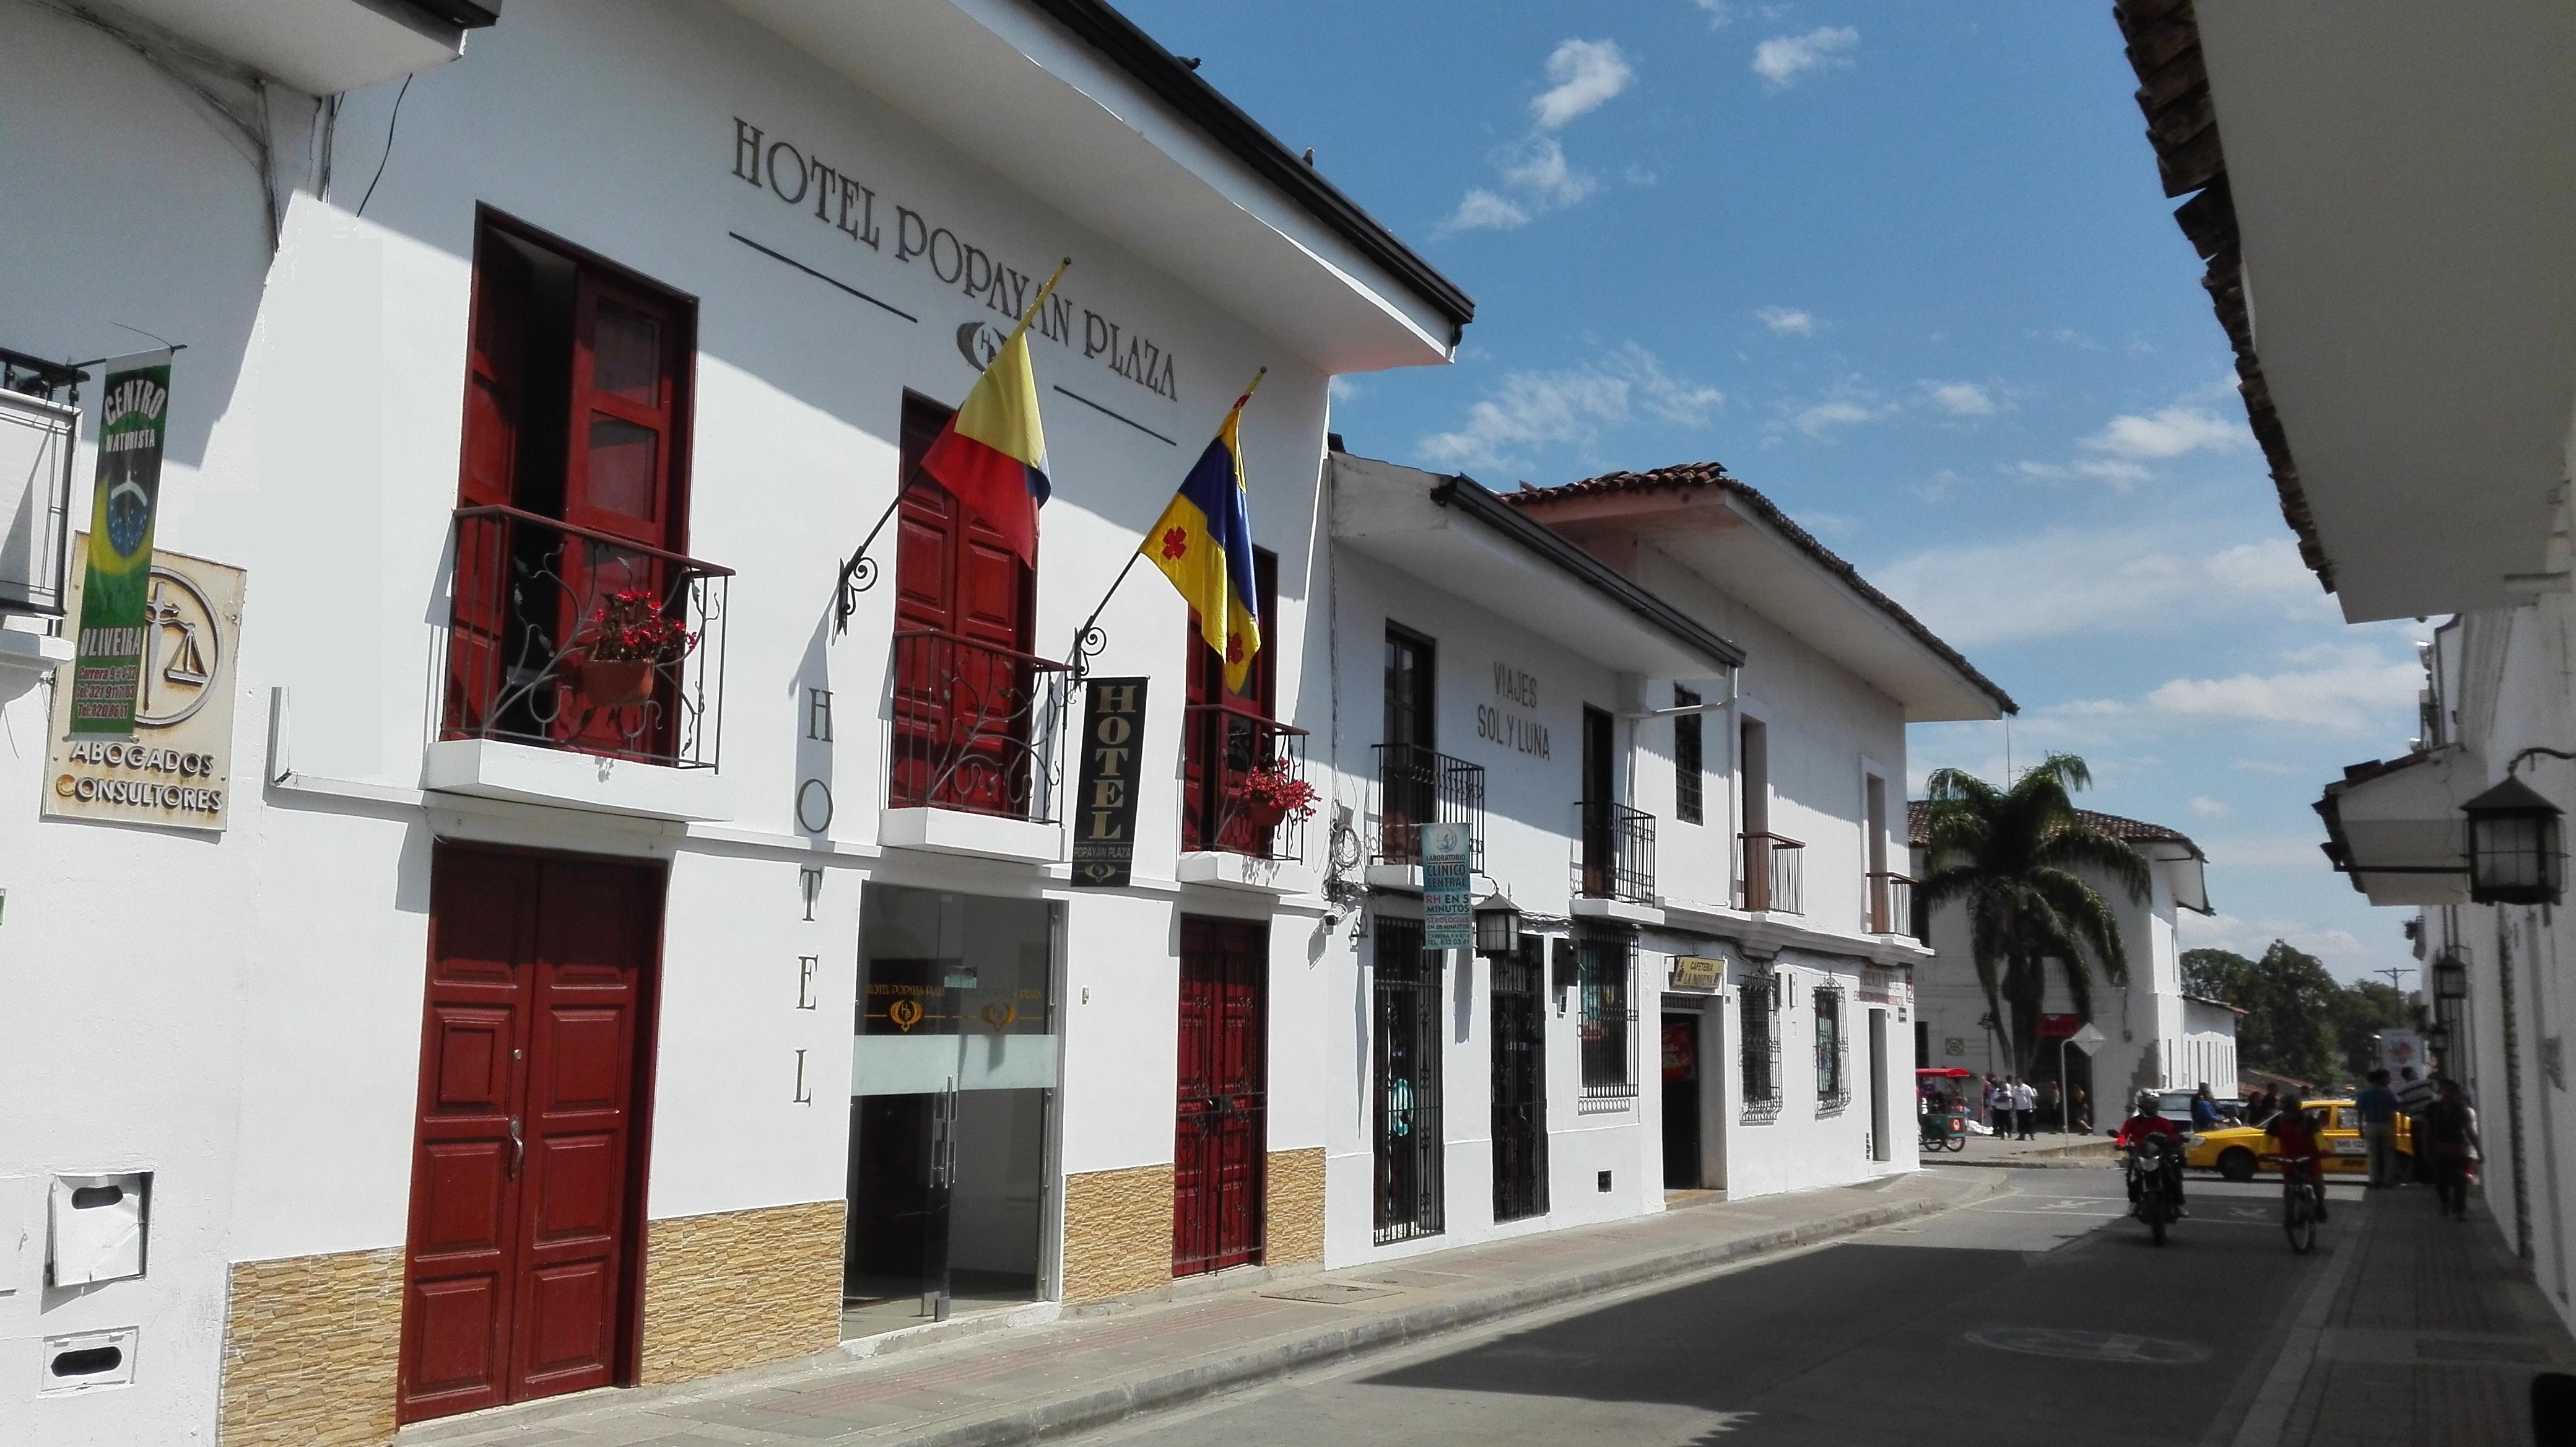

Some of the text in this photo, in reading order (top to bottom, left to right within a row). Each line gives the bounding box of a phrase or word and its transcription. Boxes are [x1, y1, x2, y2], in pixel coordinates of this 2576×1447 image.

[731, 116, 880, 253] HOTEL
[1083, 309, 1177, 402] PLAZA
[104, 379, 167, 426] CENTRO
[105, 429, 155, 453] NATURISTA
[80, 627, 142, 657] OLIVEIRA
[79, 666, 110, 681] Carrera
[1494, 661, 1537, 709] VIAJES
[1477, 704, 1550, 762] SOL Y LUNA
[69, 743, 215, 778] ABOGADOS
[1089, 684, 1138, 839] HOTEL
[56, 774, 224, 814] CONSULTORES
[1108, 847, 1131, 858] PLAZA
[1427, 862, 1466, 876] CLÍNICO
[793, 688, 833, 1108] HOTEL
[1426, 894, 1469, 904] RH EN 5
[1427, 904, 1469, 912] MINUTOS
